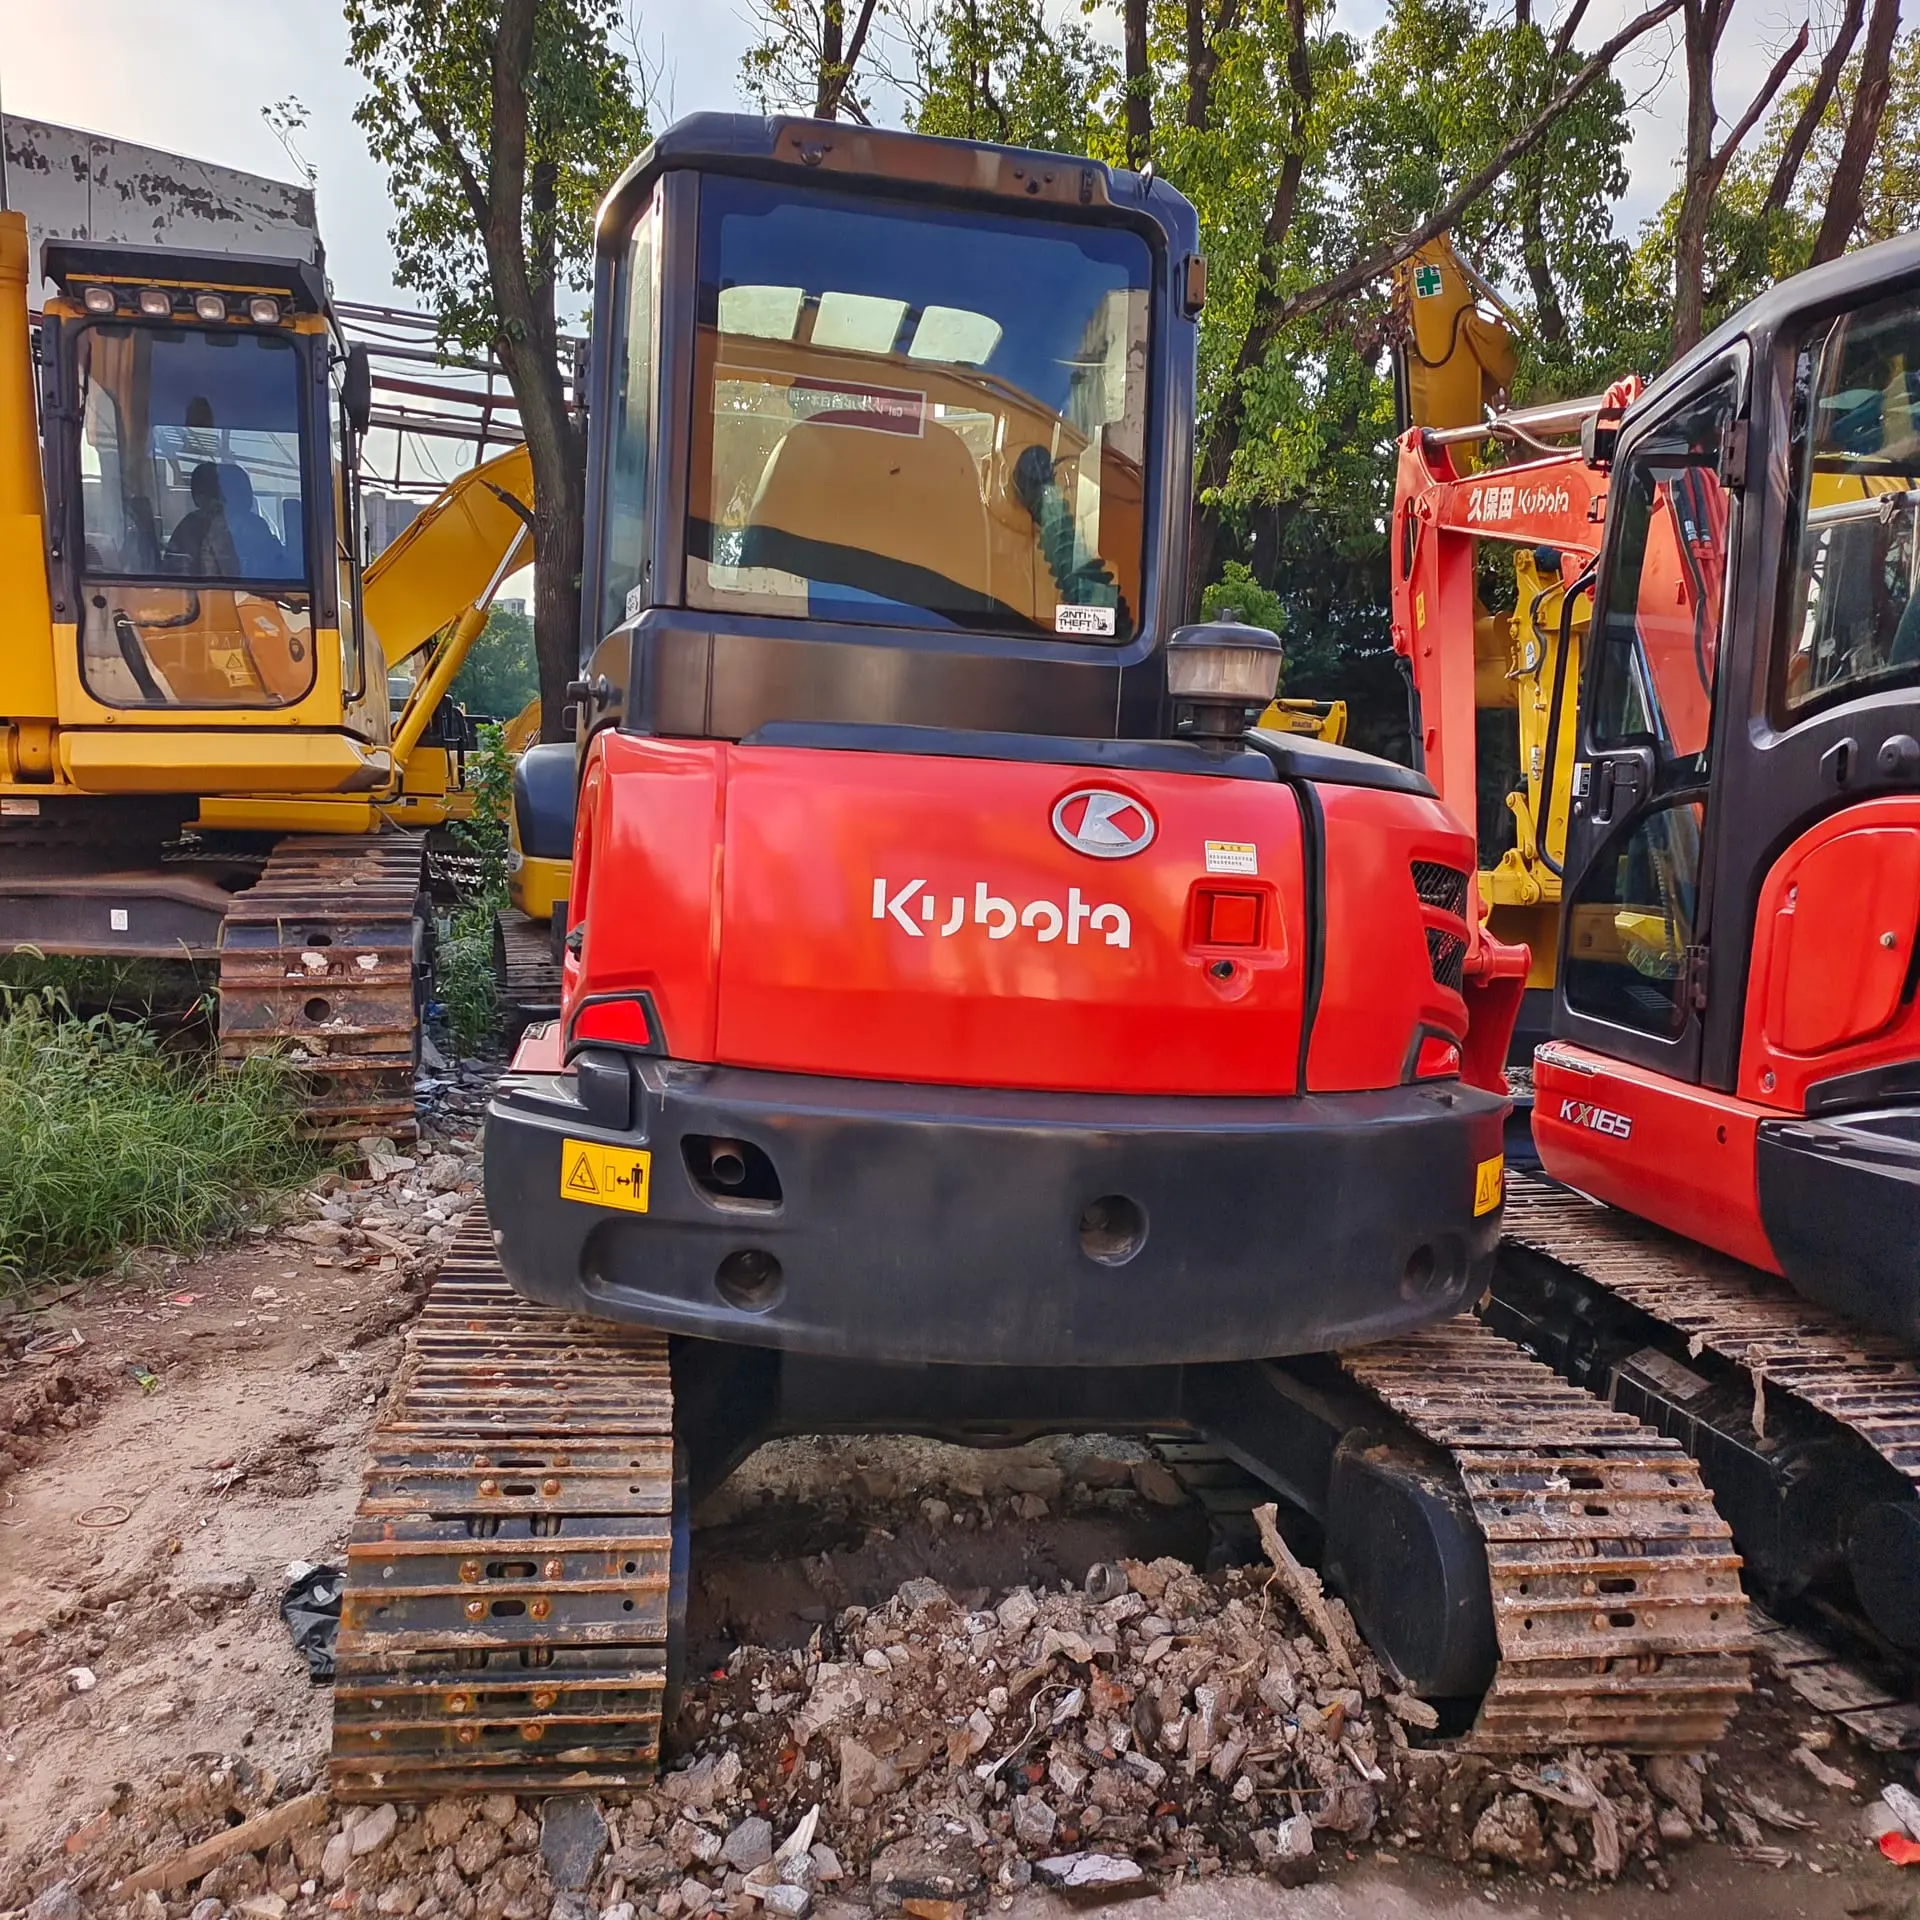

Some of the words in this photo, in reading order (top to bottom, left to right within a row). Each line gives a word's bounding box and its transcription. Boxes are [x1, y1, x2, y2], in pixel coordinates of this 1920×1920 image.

[1467, 486, 1515, 522] 久保田
[1518, 485, 1569, 515] Kubota
[1058, 618, 1092, 628] THEFT
[872, 878, 1131, 948] Kubota
[1559, 1098, 1633, 1139] KX165
